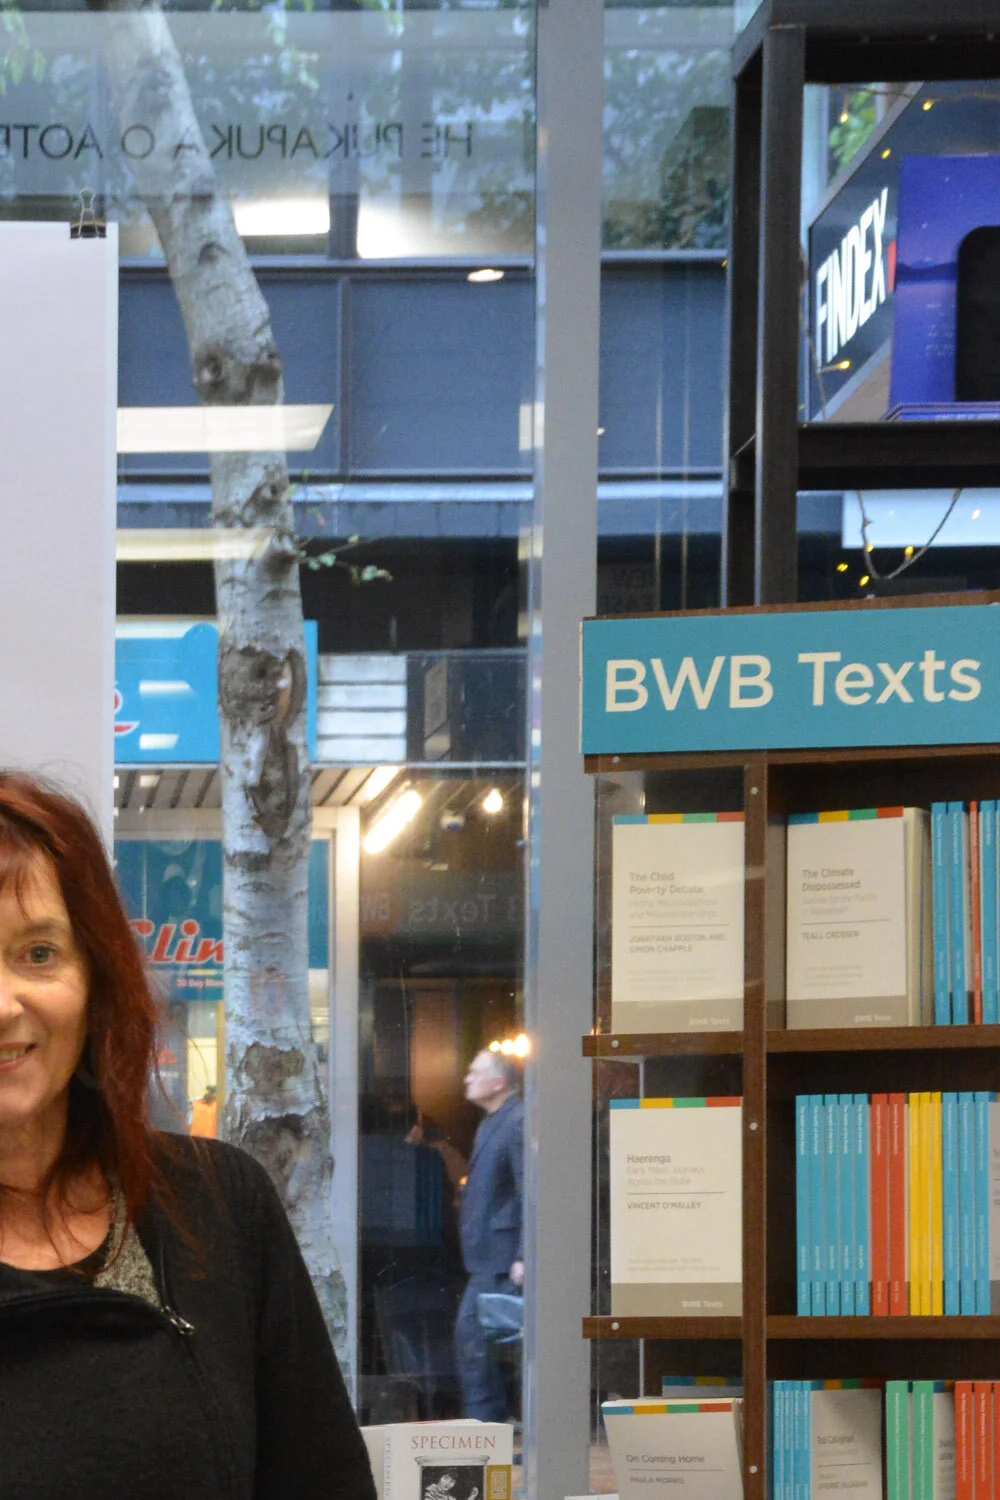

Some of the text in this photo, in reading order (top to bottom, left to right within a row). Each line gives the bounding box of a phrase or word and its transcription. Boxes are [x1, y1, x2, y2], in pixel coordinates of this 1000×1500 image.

[815, 186, 889, 368] FINDEX
[605, 650, 982, 713] BWB Texts
[626, 1154, 672, 1164] Haerenga
[627, 1202, 661, 1210] VINCENT
[411, 1436, 497, 1450] SPECIMEN
[626, 1454, 706, 1465] On Coming Home
